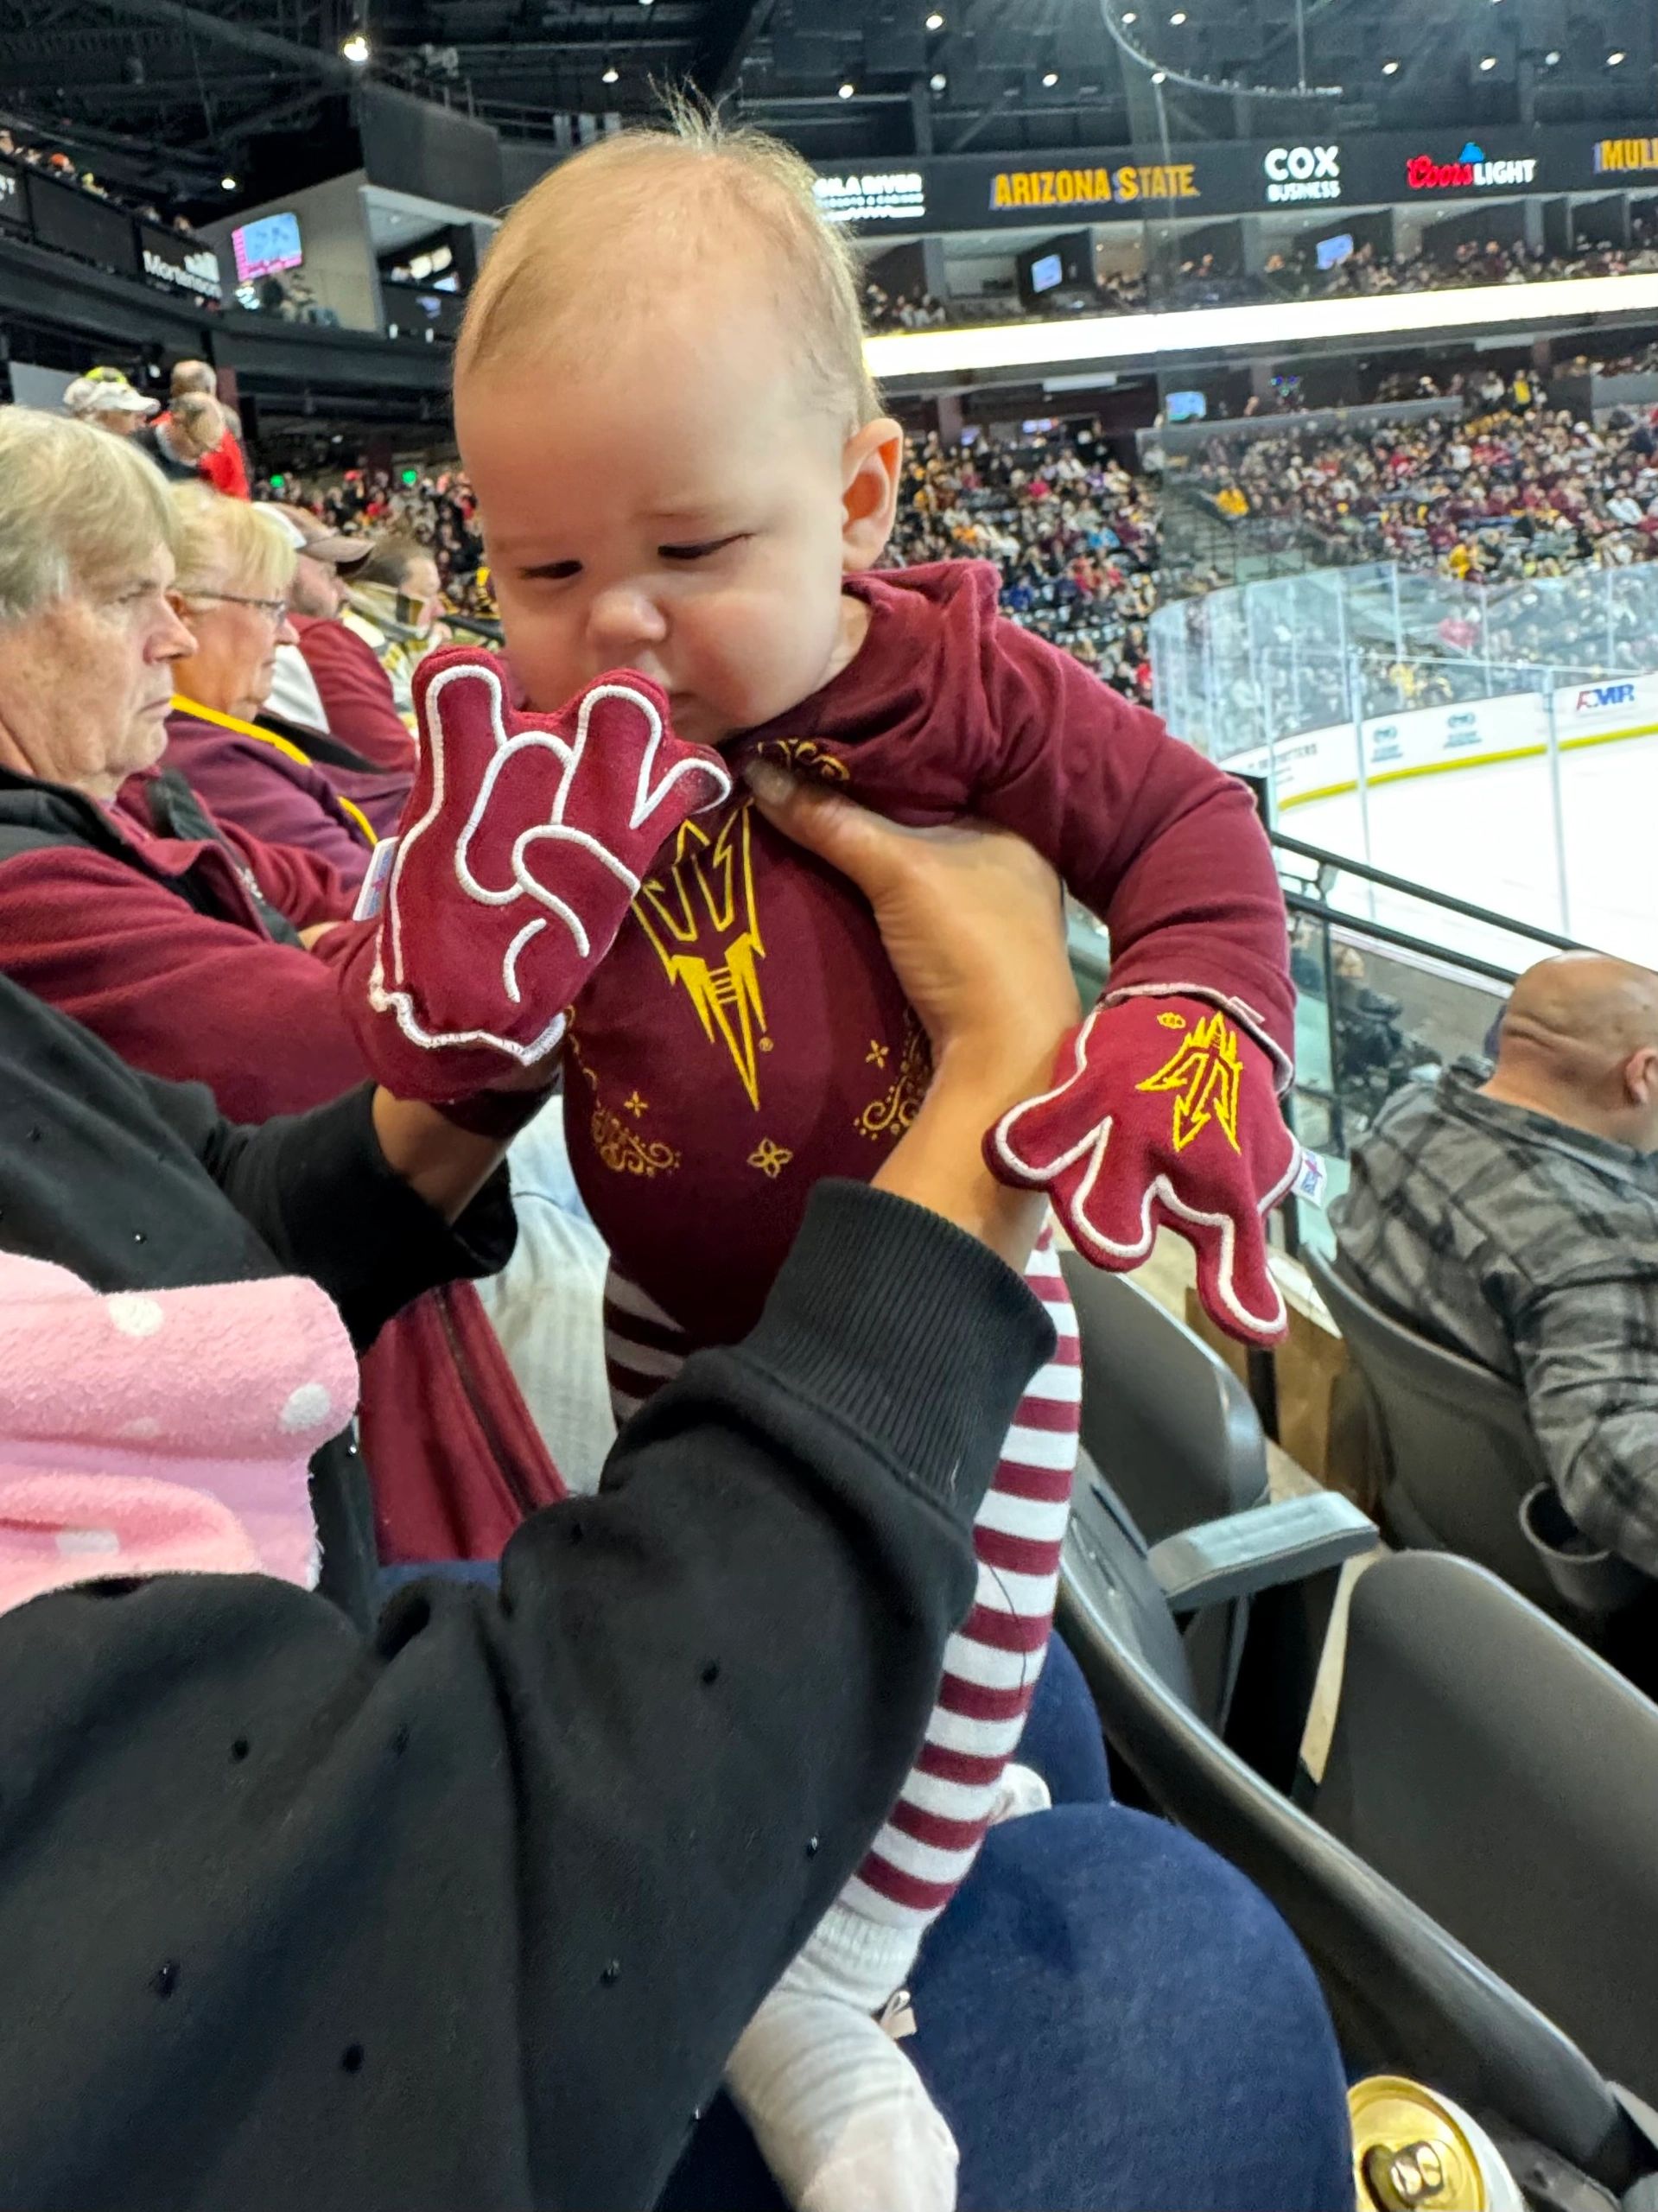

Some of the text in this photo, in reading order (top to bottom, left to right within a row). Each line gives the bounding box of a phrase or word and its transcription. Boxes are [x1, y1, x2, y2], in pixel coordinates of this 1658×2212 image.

[1264, 145, 1340, 181] COX
[1472, 158, 1536, 186] LIGHT
[991, 163, 1200, 208] ARIZONA STATE
